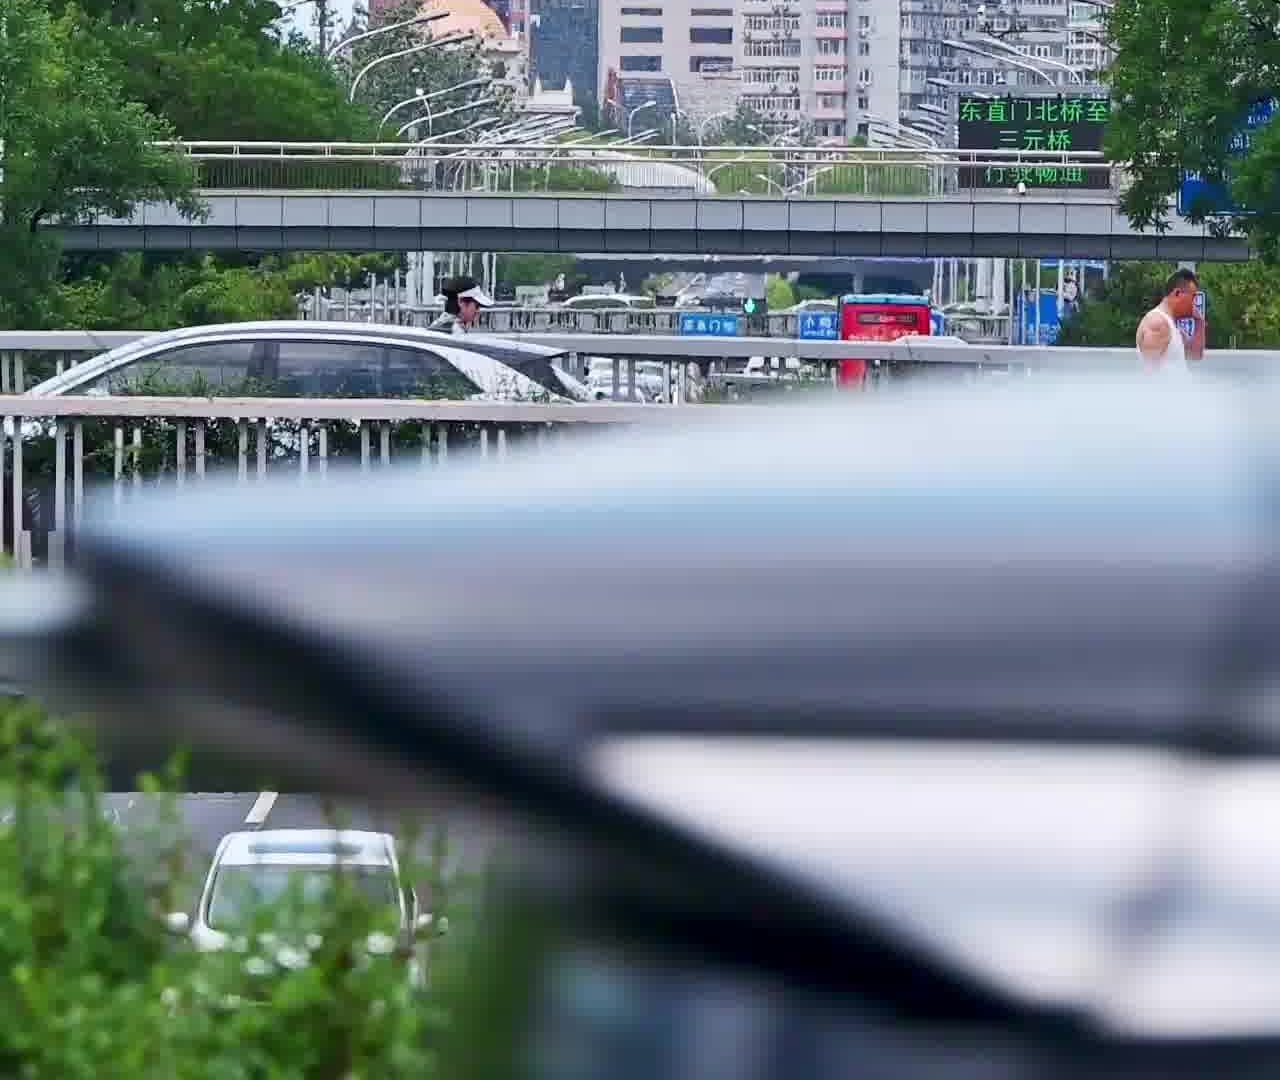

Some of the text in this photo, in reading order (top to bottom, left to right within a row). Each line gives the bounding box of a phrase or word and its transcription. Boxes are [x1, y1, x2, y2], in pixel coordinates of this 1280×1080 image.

[961, 99, 1108, 122] 东直门北桥至
[999, 129, 1072, 151] 三元桥
